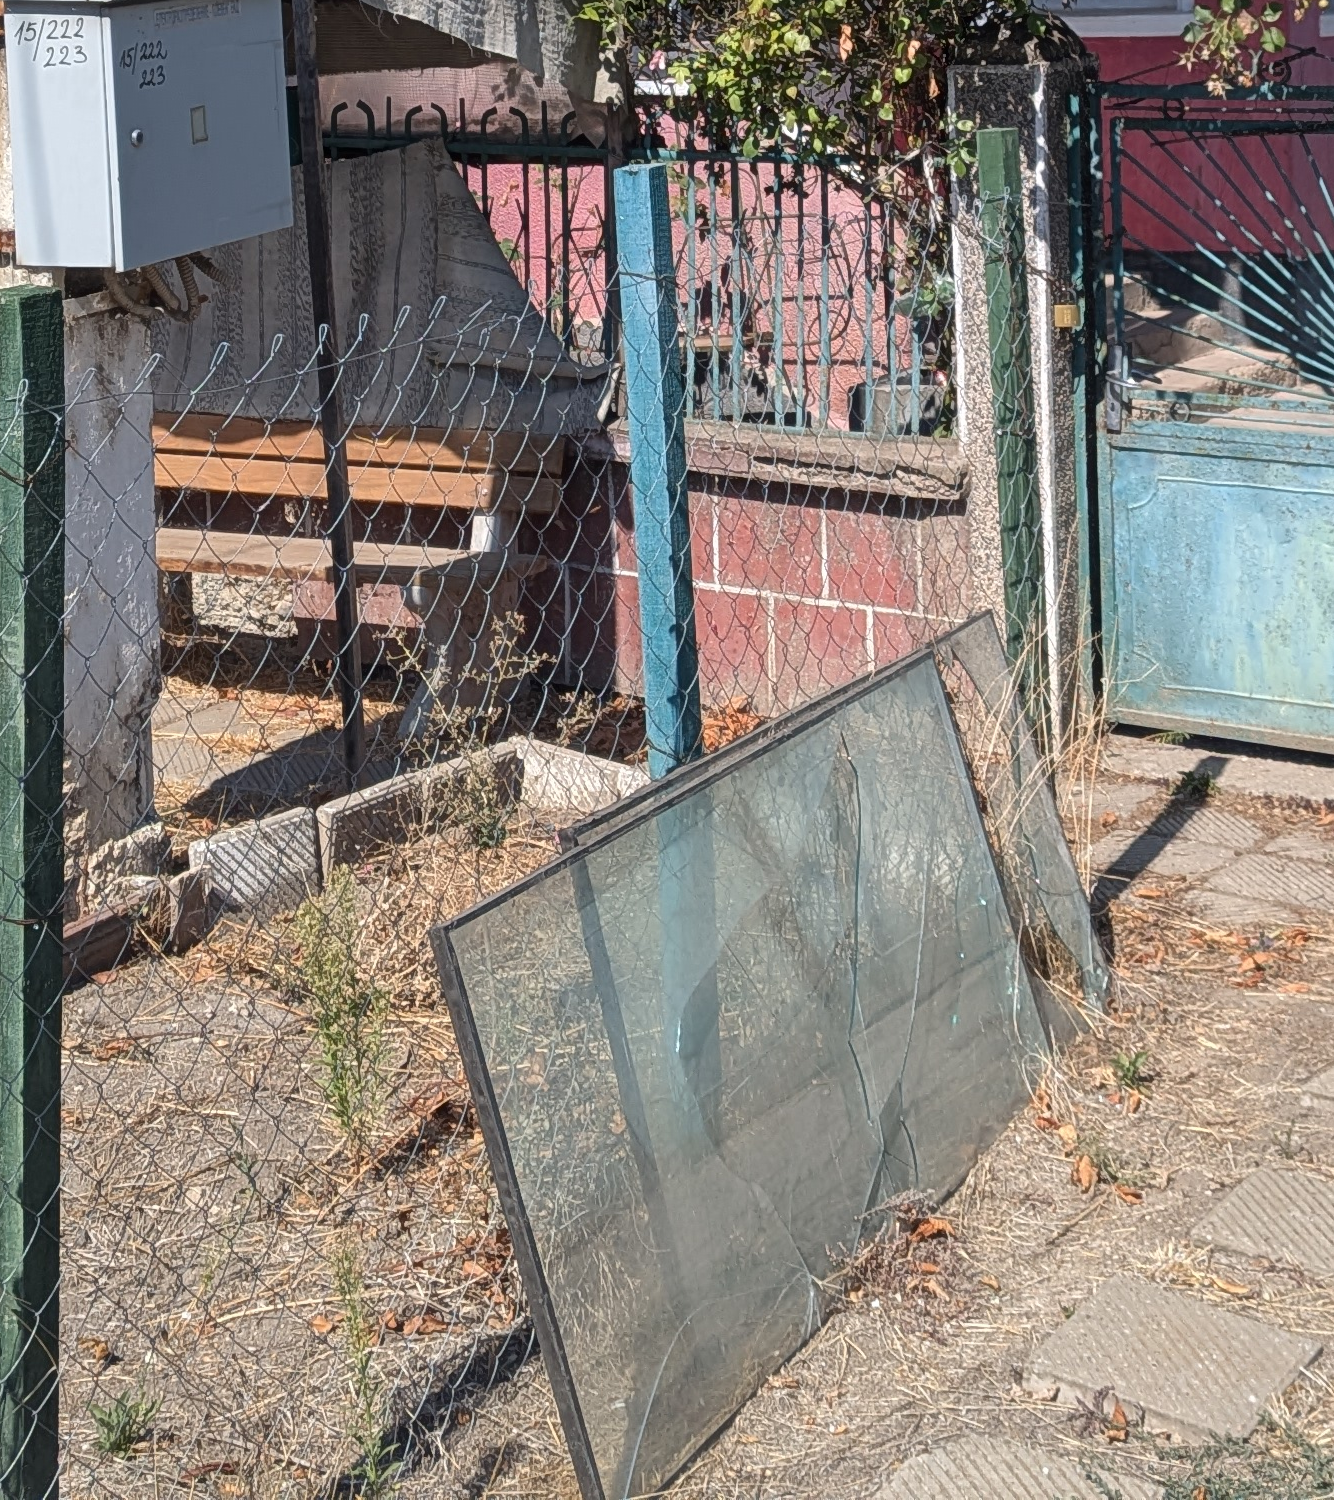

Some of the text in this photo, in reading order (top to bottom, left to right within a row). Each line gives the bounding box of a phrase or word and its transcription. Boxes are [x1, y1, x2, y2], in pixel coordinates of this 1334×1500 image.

[14, 17, 84, 61] 15/222
[43, 45, 88, 68] 223
[120, 40, 168, 75] 15/222
[139, 65, 166, 89] 223
